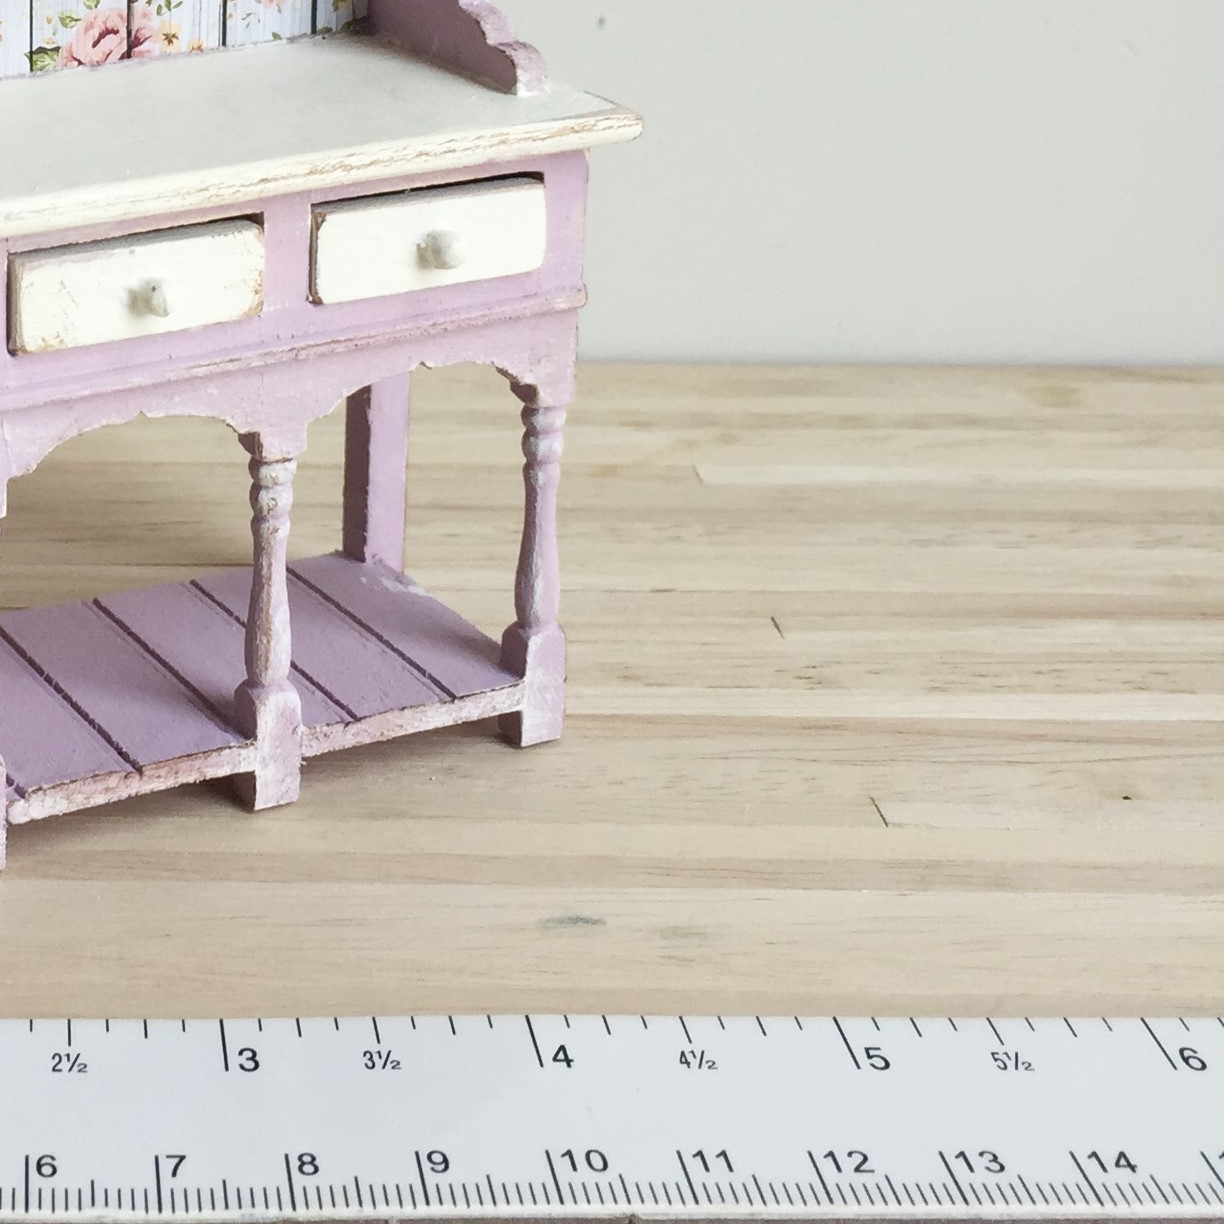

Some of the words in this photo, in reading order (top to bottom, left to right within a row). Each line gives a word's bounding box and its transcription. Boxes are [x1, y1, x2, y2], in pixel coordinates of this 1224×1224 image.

[237, 1047, 260, 1073] 3
[551, 1044, 575, 1069] 4
[863, 1046, 891, 1071] 5
[1178, 1046, 1208, 1072] 6
[35, 1154, 58, 1178] 6
[165, 1154, 187, 1178] 7
[297, 1152, 320, 1177] 8
[426, 1150, 450, 1174] 9
[560, 1149, 609, 1173] 10
[692, 1149, 734, 1173] 11
[823, 1150, 875, 1174] 12
[954, 1150, 1006, 1174] 13
[1087, 1150, 1138, 1174] 14
